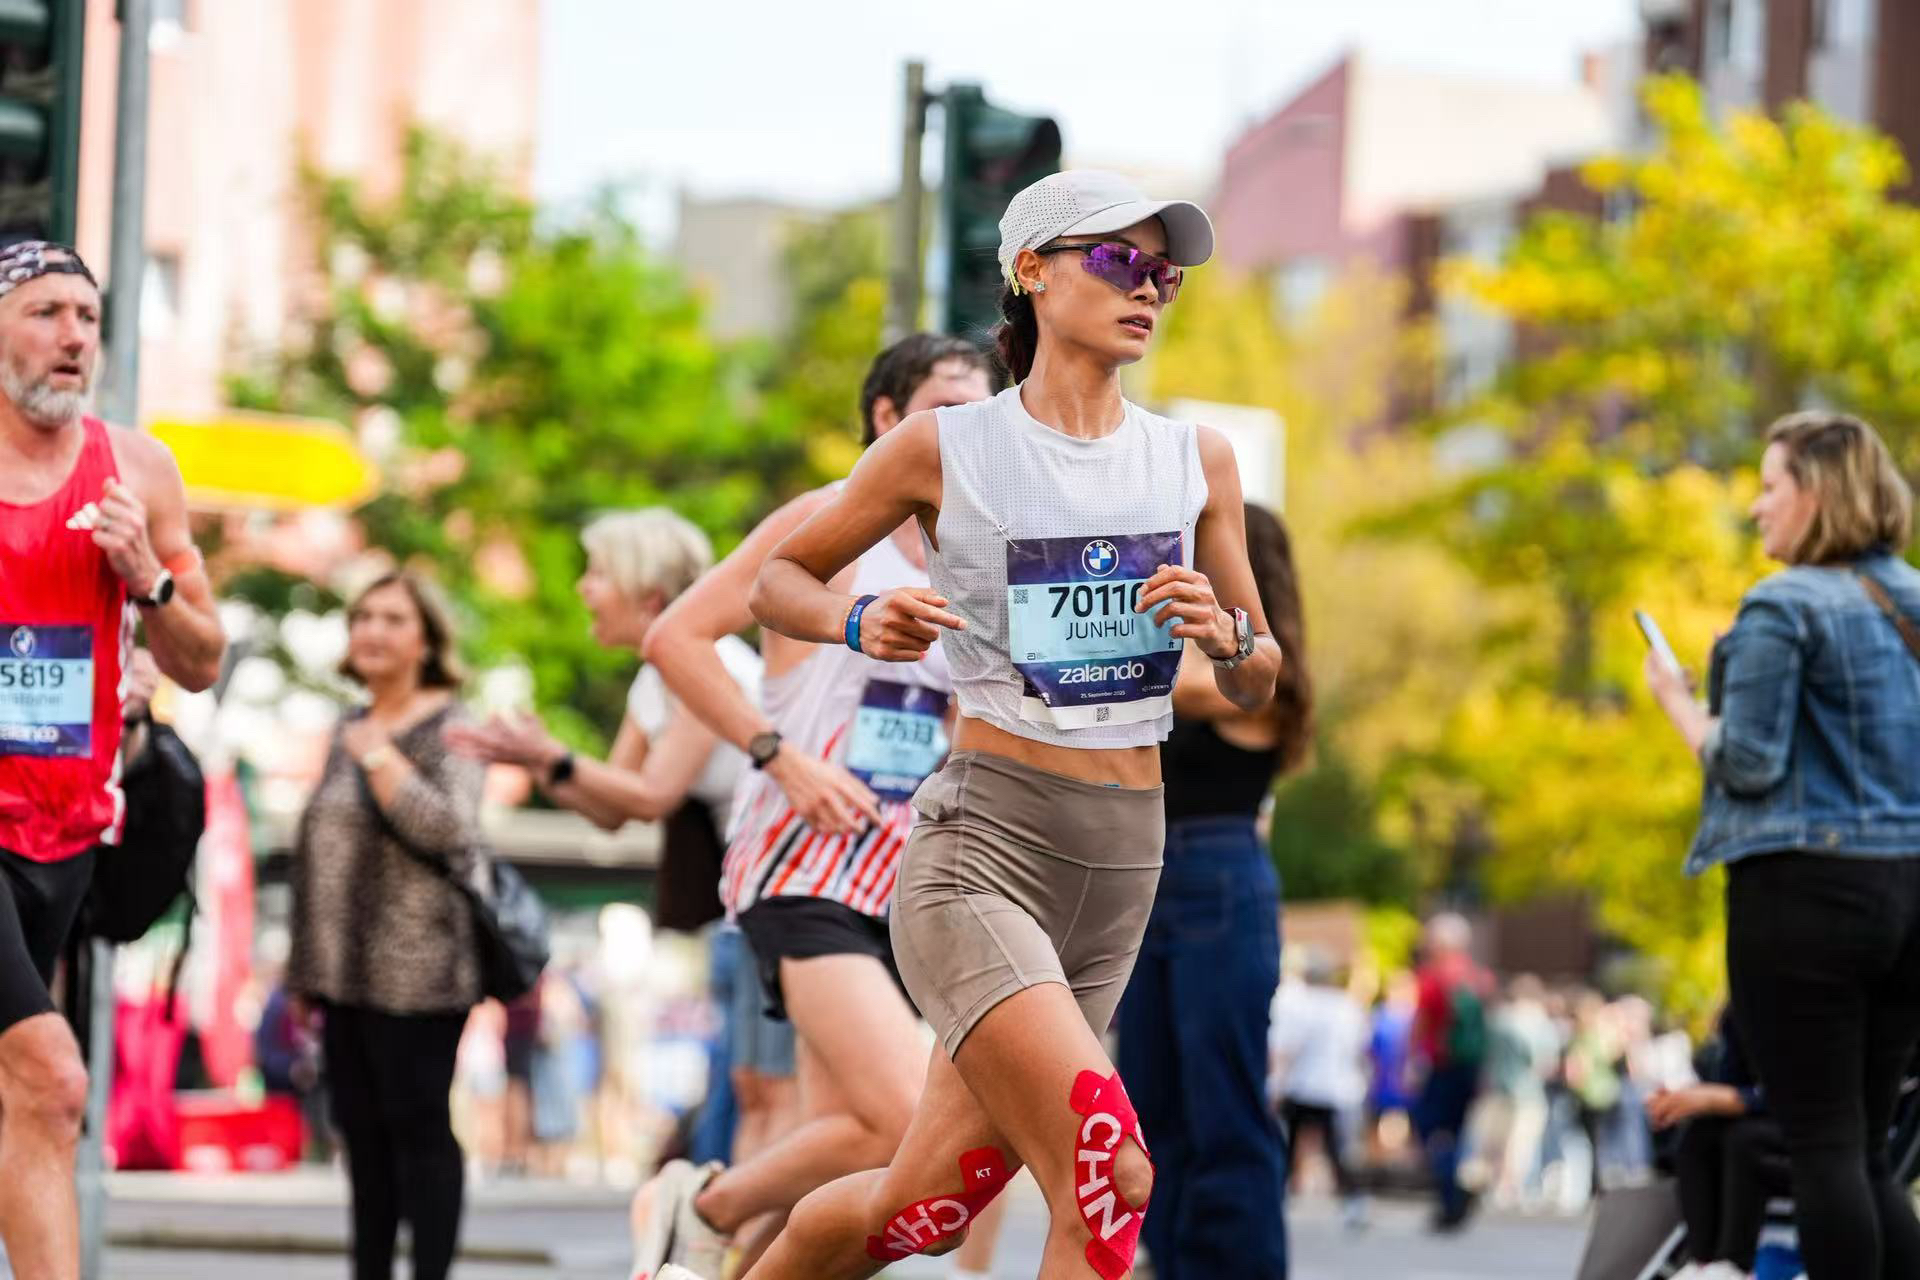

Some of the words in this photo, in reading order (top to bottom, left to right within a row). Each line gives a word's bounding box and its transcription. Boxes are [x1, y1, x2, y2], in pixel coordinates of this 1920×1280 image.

[1086, 541, 1114, 552] BMW
[1066, 618, 1134, 640] JUNHUI
[1058, 661, 1145, 684] zalando
[975, 1167, 992, 1179] KT
[1078, 1112, 1133, 1241] CHN
